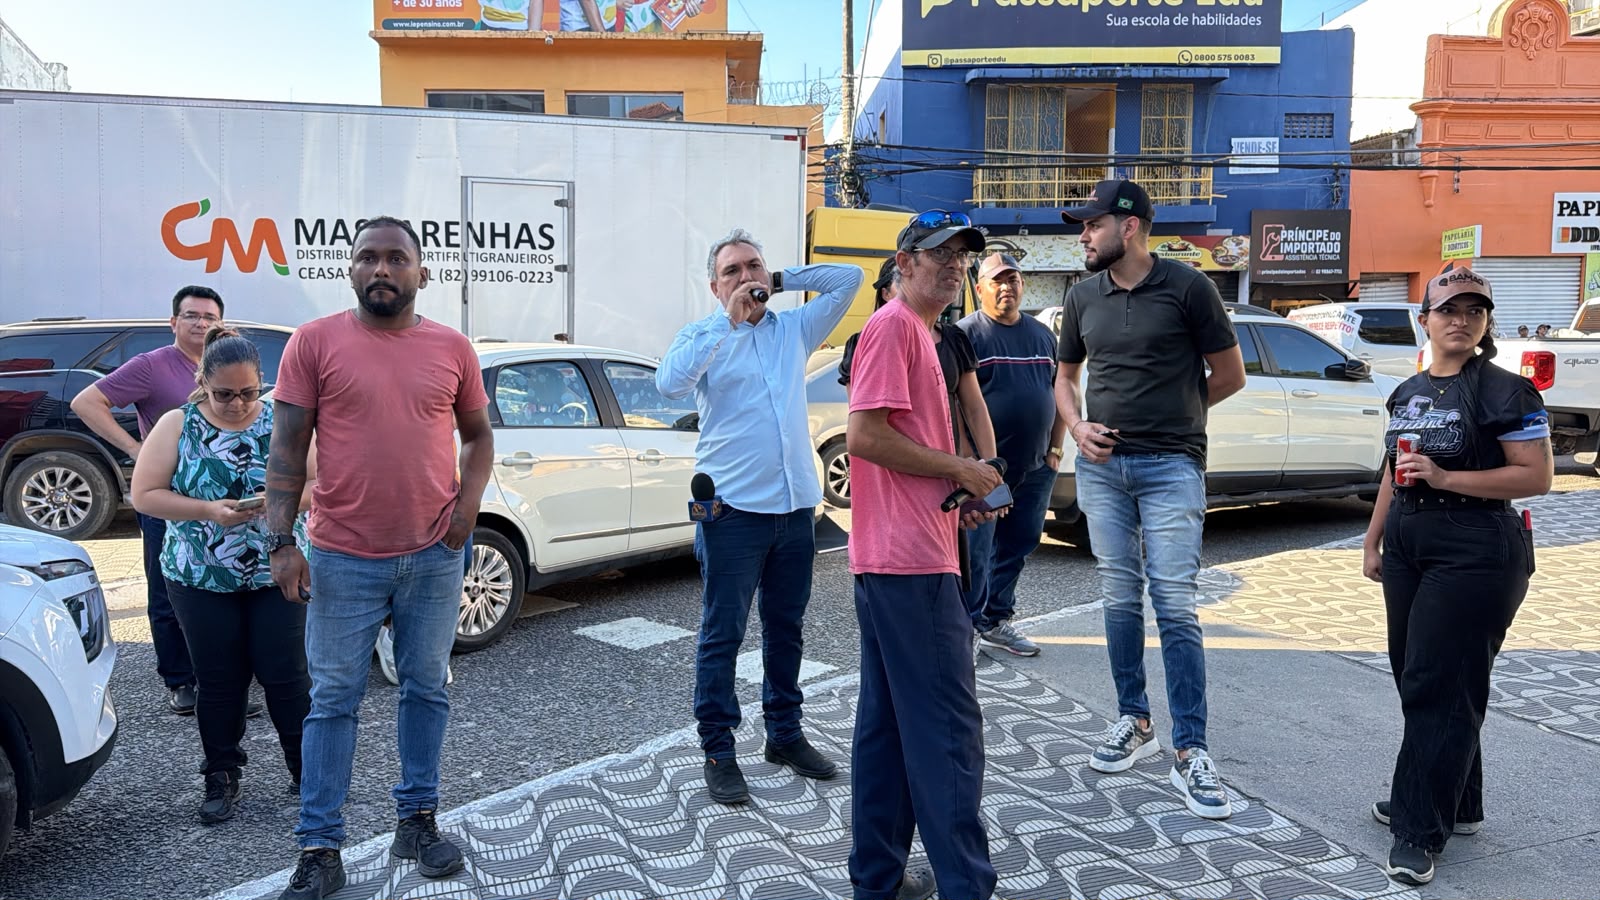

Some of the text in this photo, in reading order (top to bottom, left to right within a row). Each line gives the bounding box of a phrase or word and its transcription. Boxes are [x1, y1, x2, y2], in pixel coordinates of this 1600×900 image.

[1106, 13, 1262, 26] Sua escola de habilidades
[944, 56, 1007, 65] @passaporteedu
[1194, 53, 1256, 62] 0800 575 0083
[1233, 141, 1277, 154] VENDE-SE
[294, 218, 555, 250] MARENHAS
[1281, 226, 1341, 241] PRÍNCIPE DO
[1570, 227, 1600, 243] DID
[297, 249, 352, 260] DISTRIBU
[1280, 242, 1341, 254] IMPORTADO
[1319, 253, 1341, 261] TÉCNICA
[298, 267, 351, 280] CEASA-
[439, 268, 468, 284] (82)
[471, 269, 554, 284] 99106-0223
[1449, 273, 1484, 286] BAMAQ
[1563, 358, 1599, 368] 4WD
